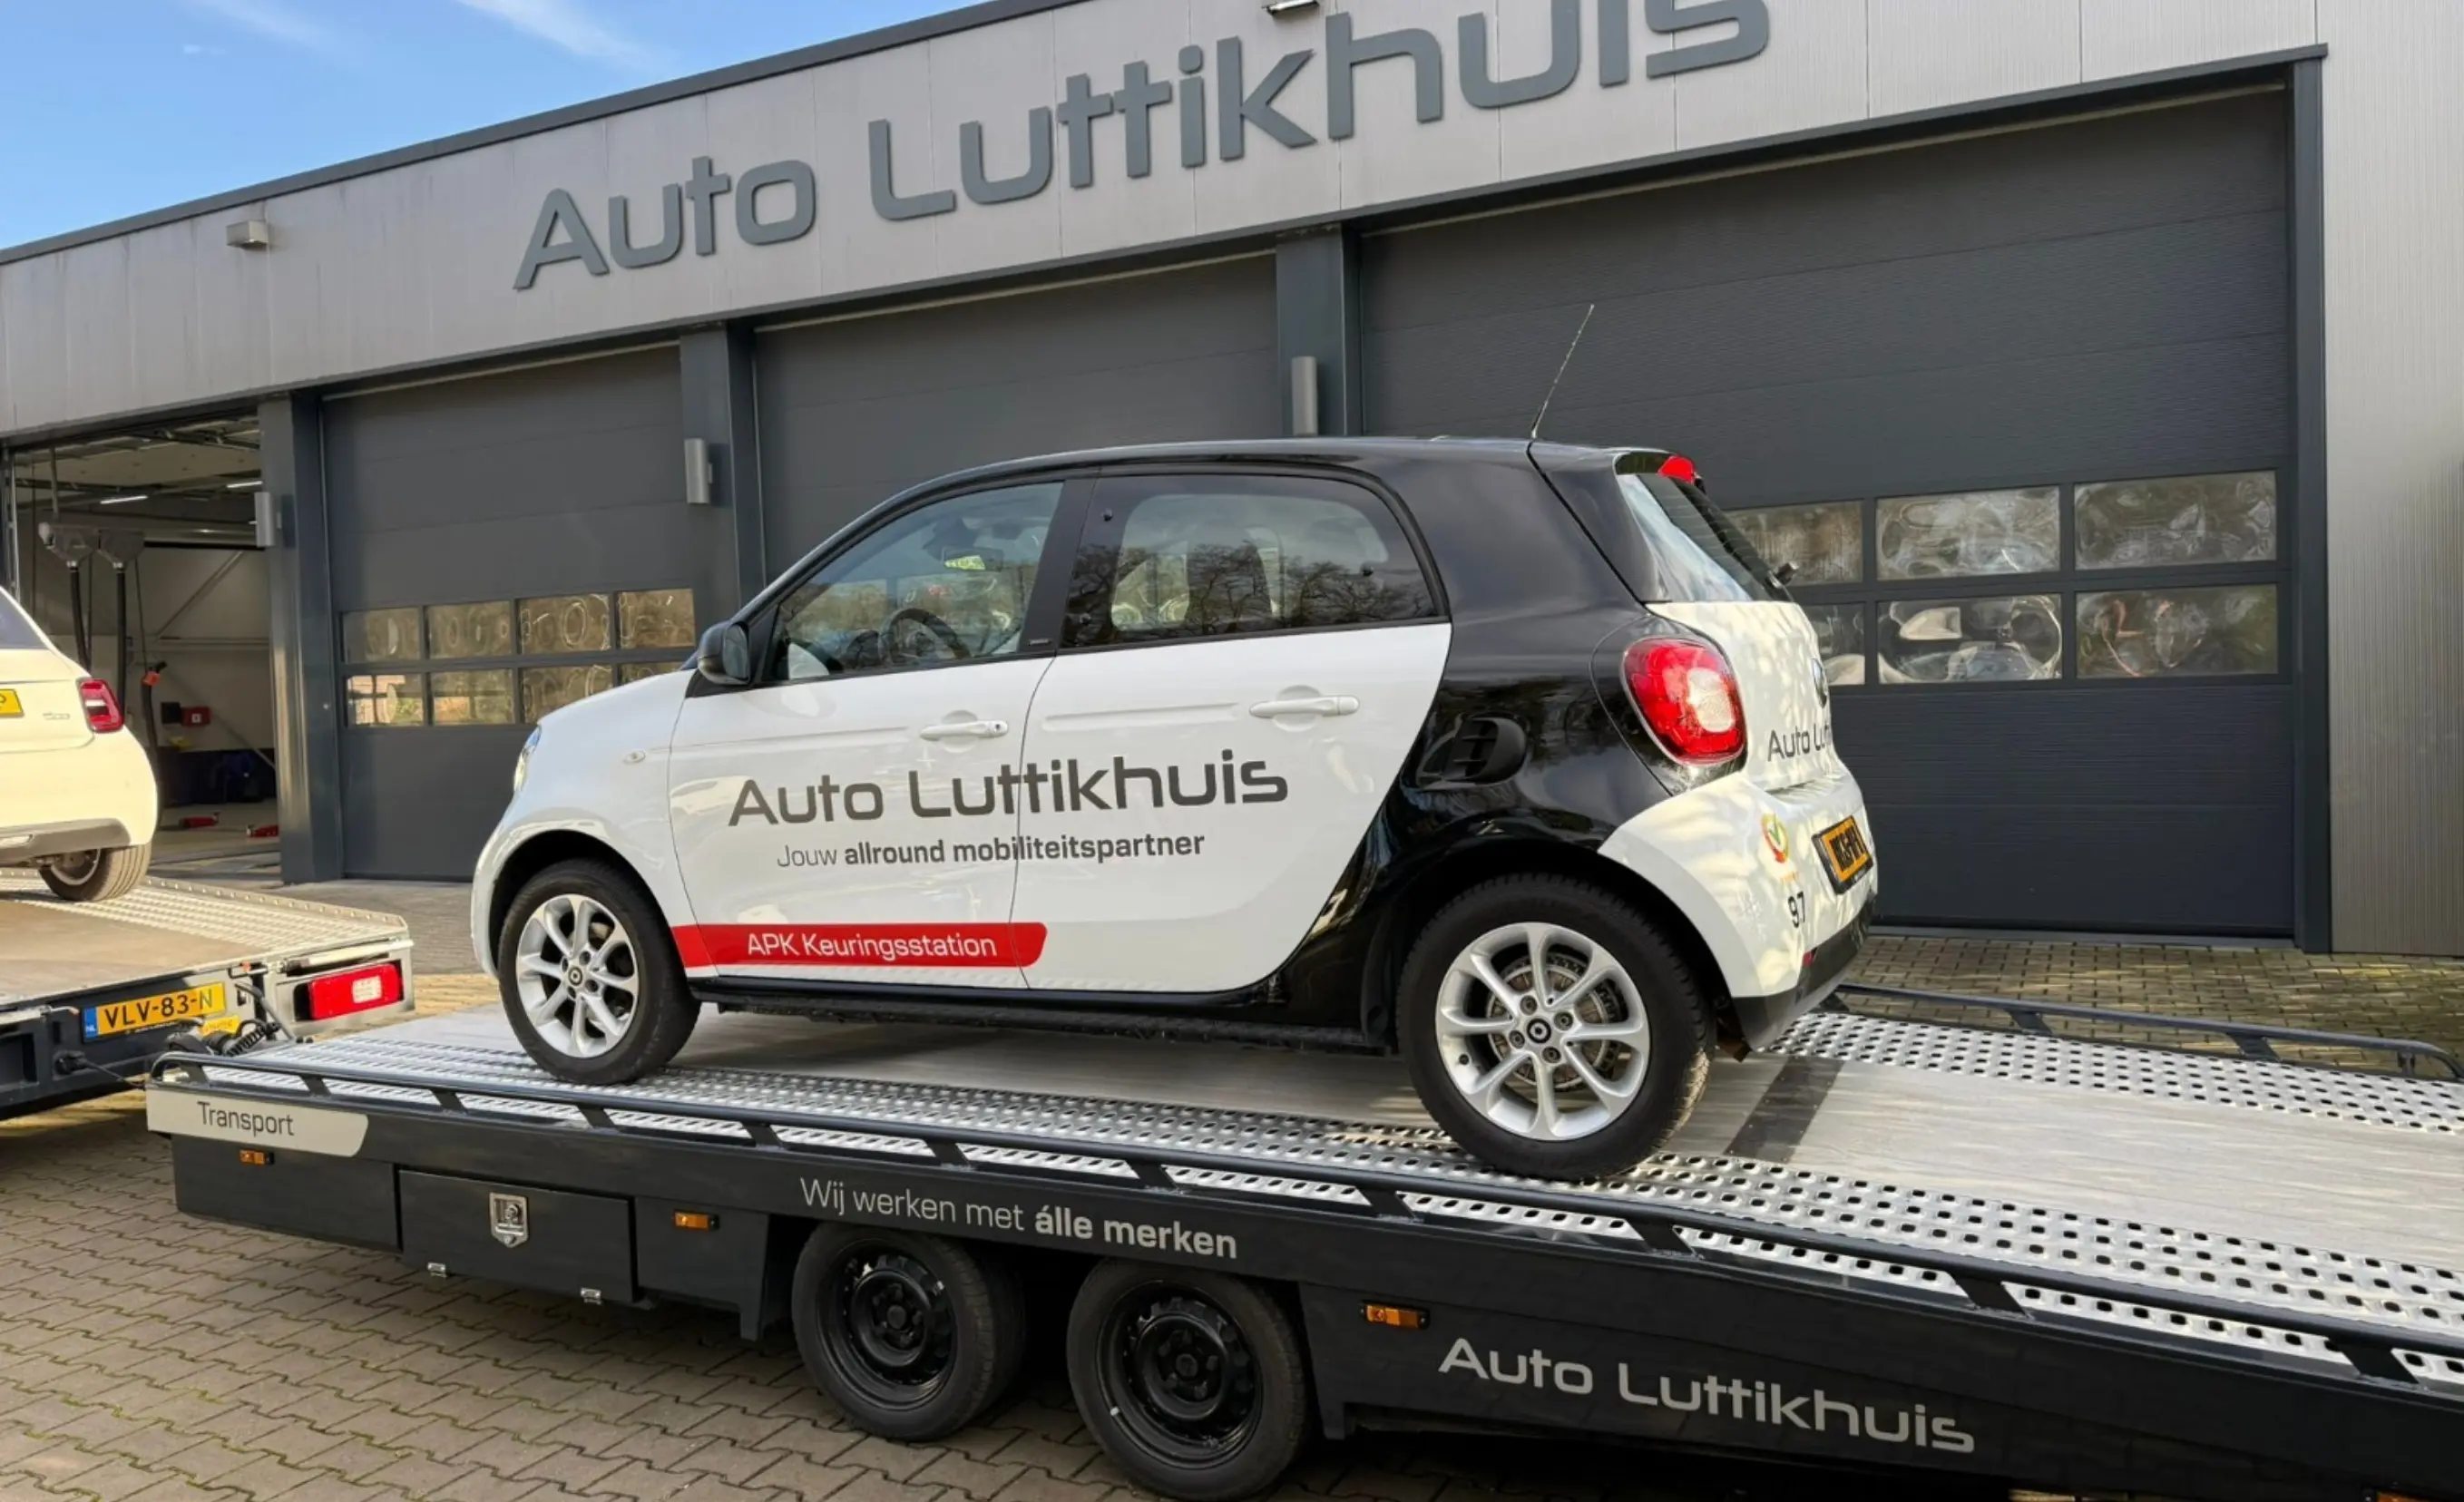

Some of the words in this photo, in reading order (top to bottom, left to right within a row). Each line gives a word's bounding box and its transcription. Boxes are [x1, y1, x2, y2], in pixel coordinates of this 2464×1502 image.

[513, 156, 816, 290] Auto
[868, 0, 1769, 221] Luttikhuis
[1767, 725, 1810, 762] Auto
[728, 774, 885, 826] Auto
[908, 748, 1289, 818] Luttikhuis
[777, 844, 837, 868] Jouw
[844, 839, 944, 865] allround
[953, 833, 1205, 863] mobiliteitspartner
[1787, 891, 1805, 929] 97
[747, 932, 799, 956] APK
[802, 932, 997, 960] Keuringsstation
[103, 988, 213, 1029] VLV-83-N
[197, 1100, 295, 1137] Transport
[800, 1177, 845, 1215] Wij
[852, 1186, 956, 1224] werken
[966, 1203, 1025, 1232] met
[1035, 1205, 1093, 1239] álle
[1103, 1218, 1237, 1259] merken
[1438, 1338, 1593, 1395] Auto
[1618, 1362, 1975, 1453] Luttikhuis
